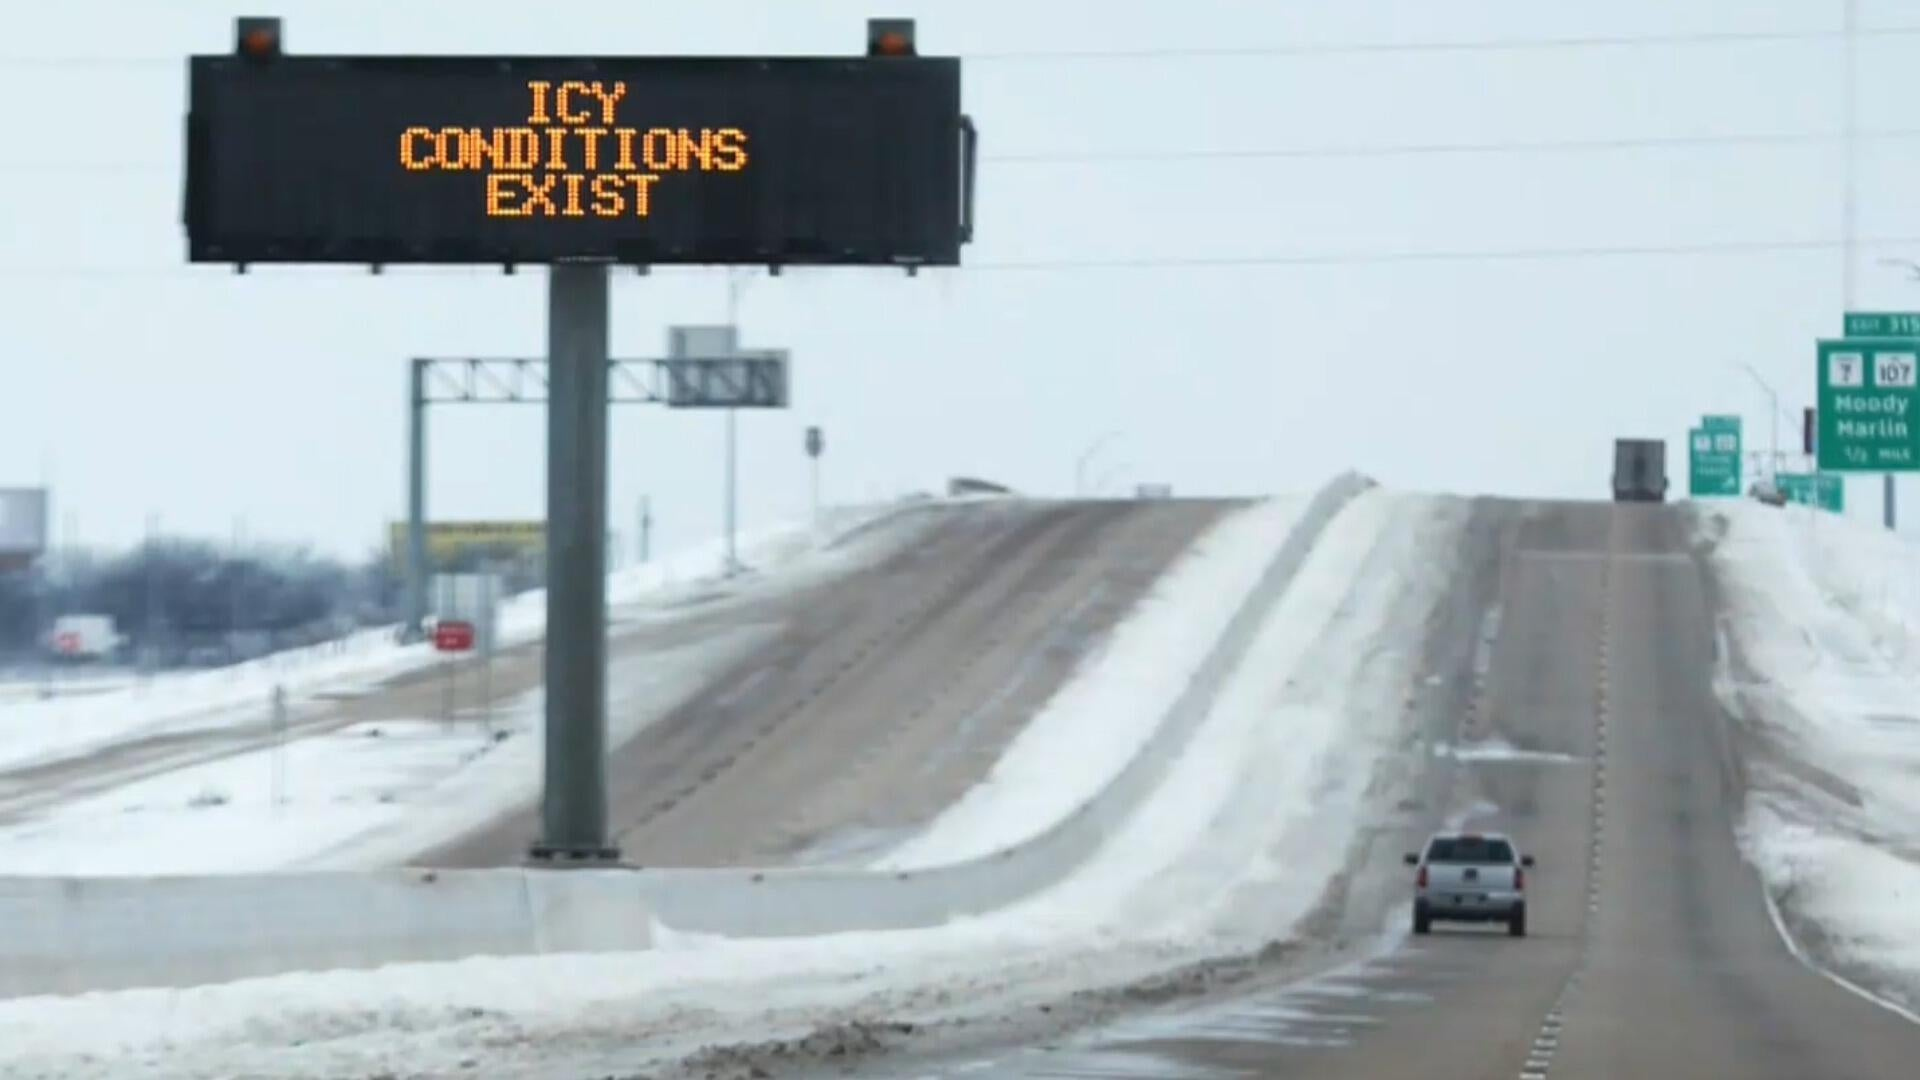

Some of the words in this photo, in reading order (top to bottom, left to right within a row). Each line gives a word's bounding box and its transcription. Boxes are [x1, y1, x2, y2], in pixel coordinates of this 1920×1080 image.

[527, 80, 627, 125] ICY
[399, 127, 749, 171] CONDITIONS
[485, 174, 660, 216] EXIST
[1840, 363, 1852, 382] 7
[1879, 362, 1911, 383] 107
[1835, 394, 1909, 415] Moody
[1837, 420, 1909, 437] Marlin
[1878, 448, 1911, 461] MILE
